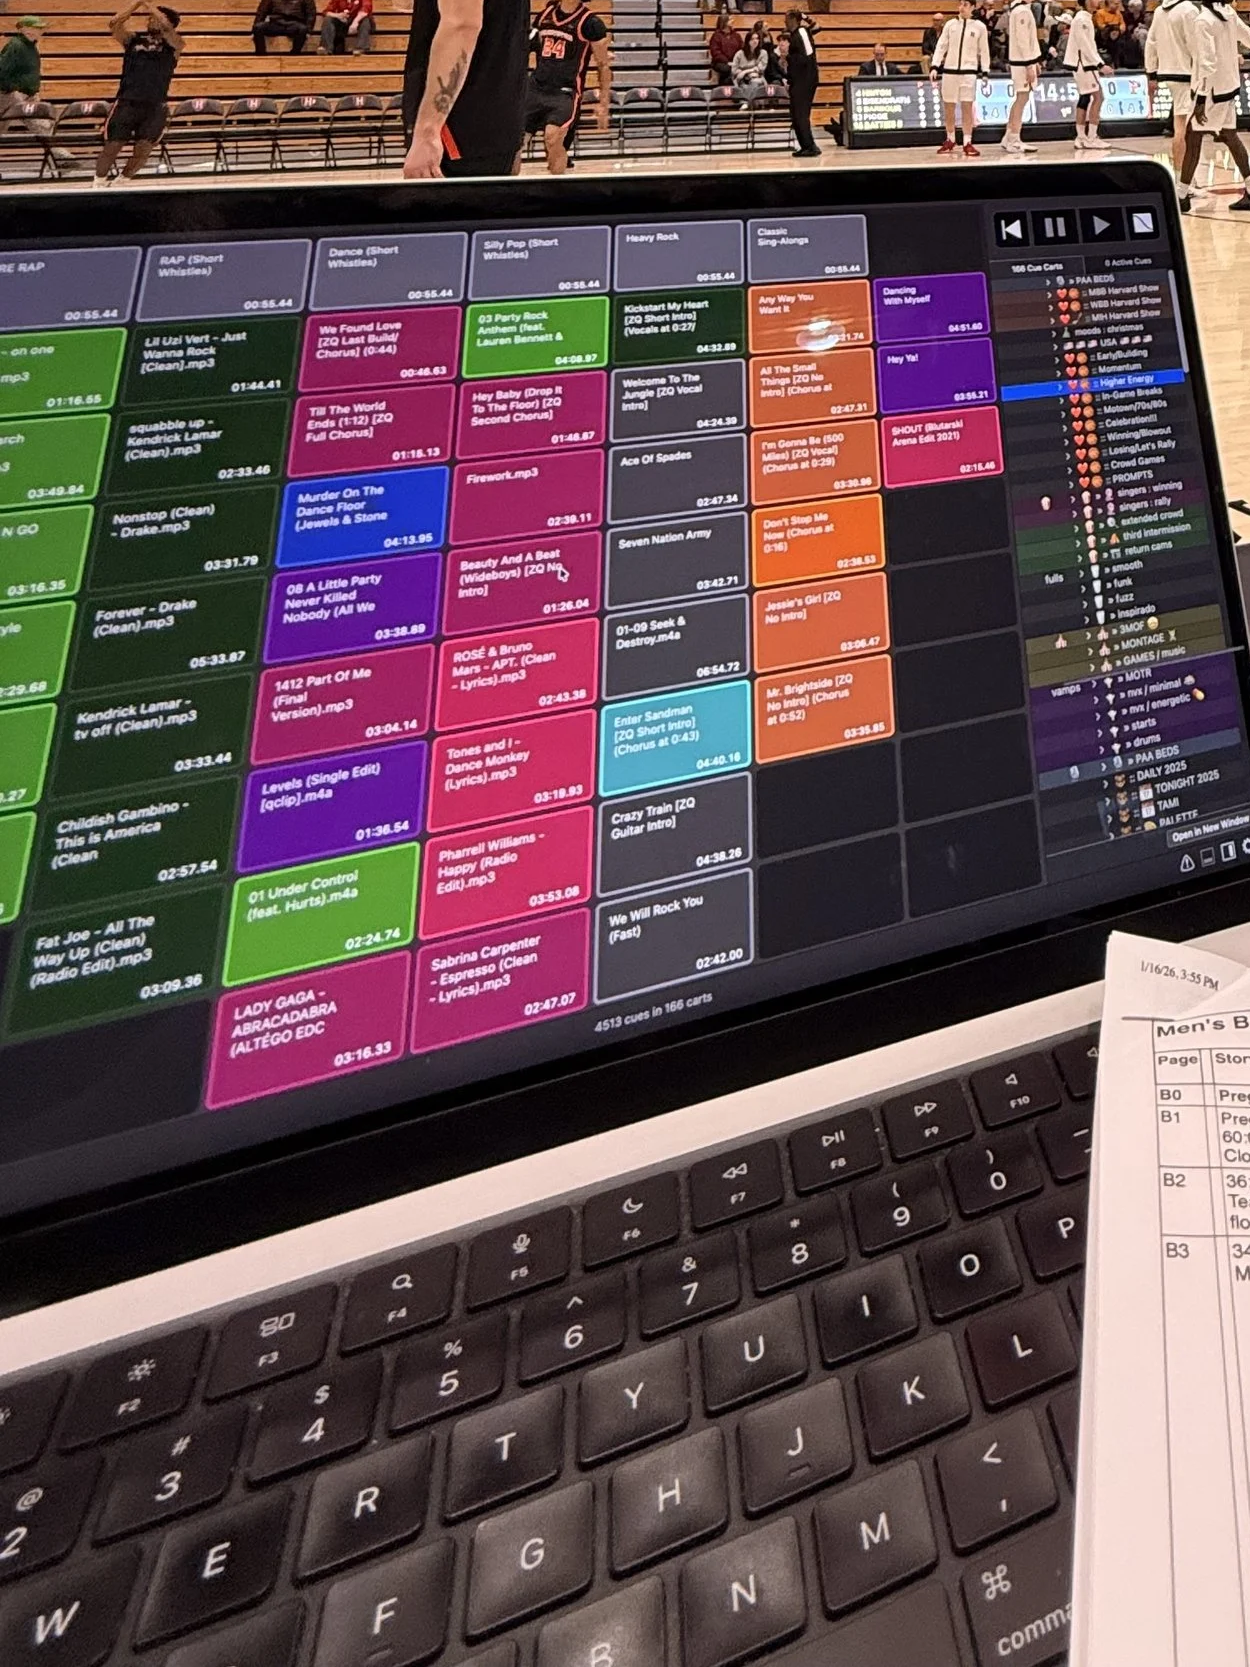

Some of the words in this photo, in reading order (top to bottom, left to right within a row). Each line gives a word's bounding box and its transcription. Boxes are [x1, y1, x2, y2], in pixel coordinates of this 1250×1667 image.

[618, 537, 645, 551] Seven
[647, 533, 685, 547] Nation
[686, 527, 712, 545] Army
[1172, 828, 1193, 845] Open
[1194, 825, 1202, 836] in
[1203, 820, 1219, 835] New
[1220, 813, 1250, 830] Window
[609, 914, 628, 928] We
[629, 907, 651, 922] Will
[652, 900, 680, 917] Rock
[682, 894, 704, 910] You
[608, 925, 641, 945] (Fast)
[696, 948, 744, 970] 02:42.00
[1140, 960, 1178, 982] 1/16/26,
[1180, 966, 1202, 985] 3:55
[1202, 973, 1220, 991] PM
[234, 999, 271, 1022] LADY
[274, 988, 316, 1010] GAGA
[595, 1016, 622, 1033] 4513
[624, 1011, 651, 1026] cues
[652, 1006, 662, 1019] in
[664, 1000, 684, 1014] 166
[686, 991, 713, 1010] carts
[231, 1001, 338, 1039] ABRACADABRA
[294, 1020, 326, 1041] EDC
[1156, 1014, 1226, 1038] Men's
[334, 1041, 392, 1067] 03:16.33
[1158, 1052, 1199, 1070] Page
[1159, 1088, 1182, 1102] B0
[1161, 1110, 1181, 1124] B1
[1163, 1173, 1187, 1189] B2
[1165, 1242, 1191, 1259] B3
[860, 1513, 890, 1550] M
